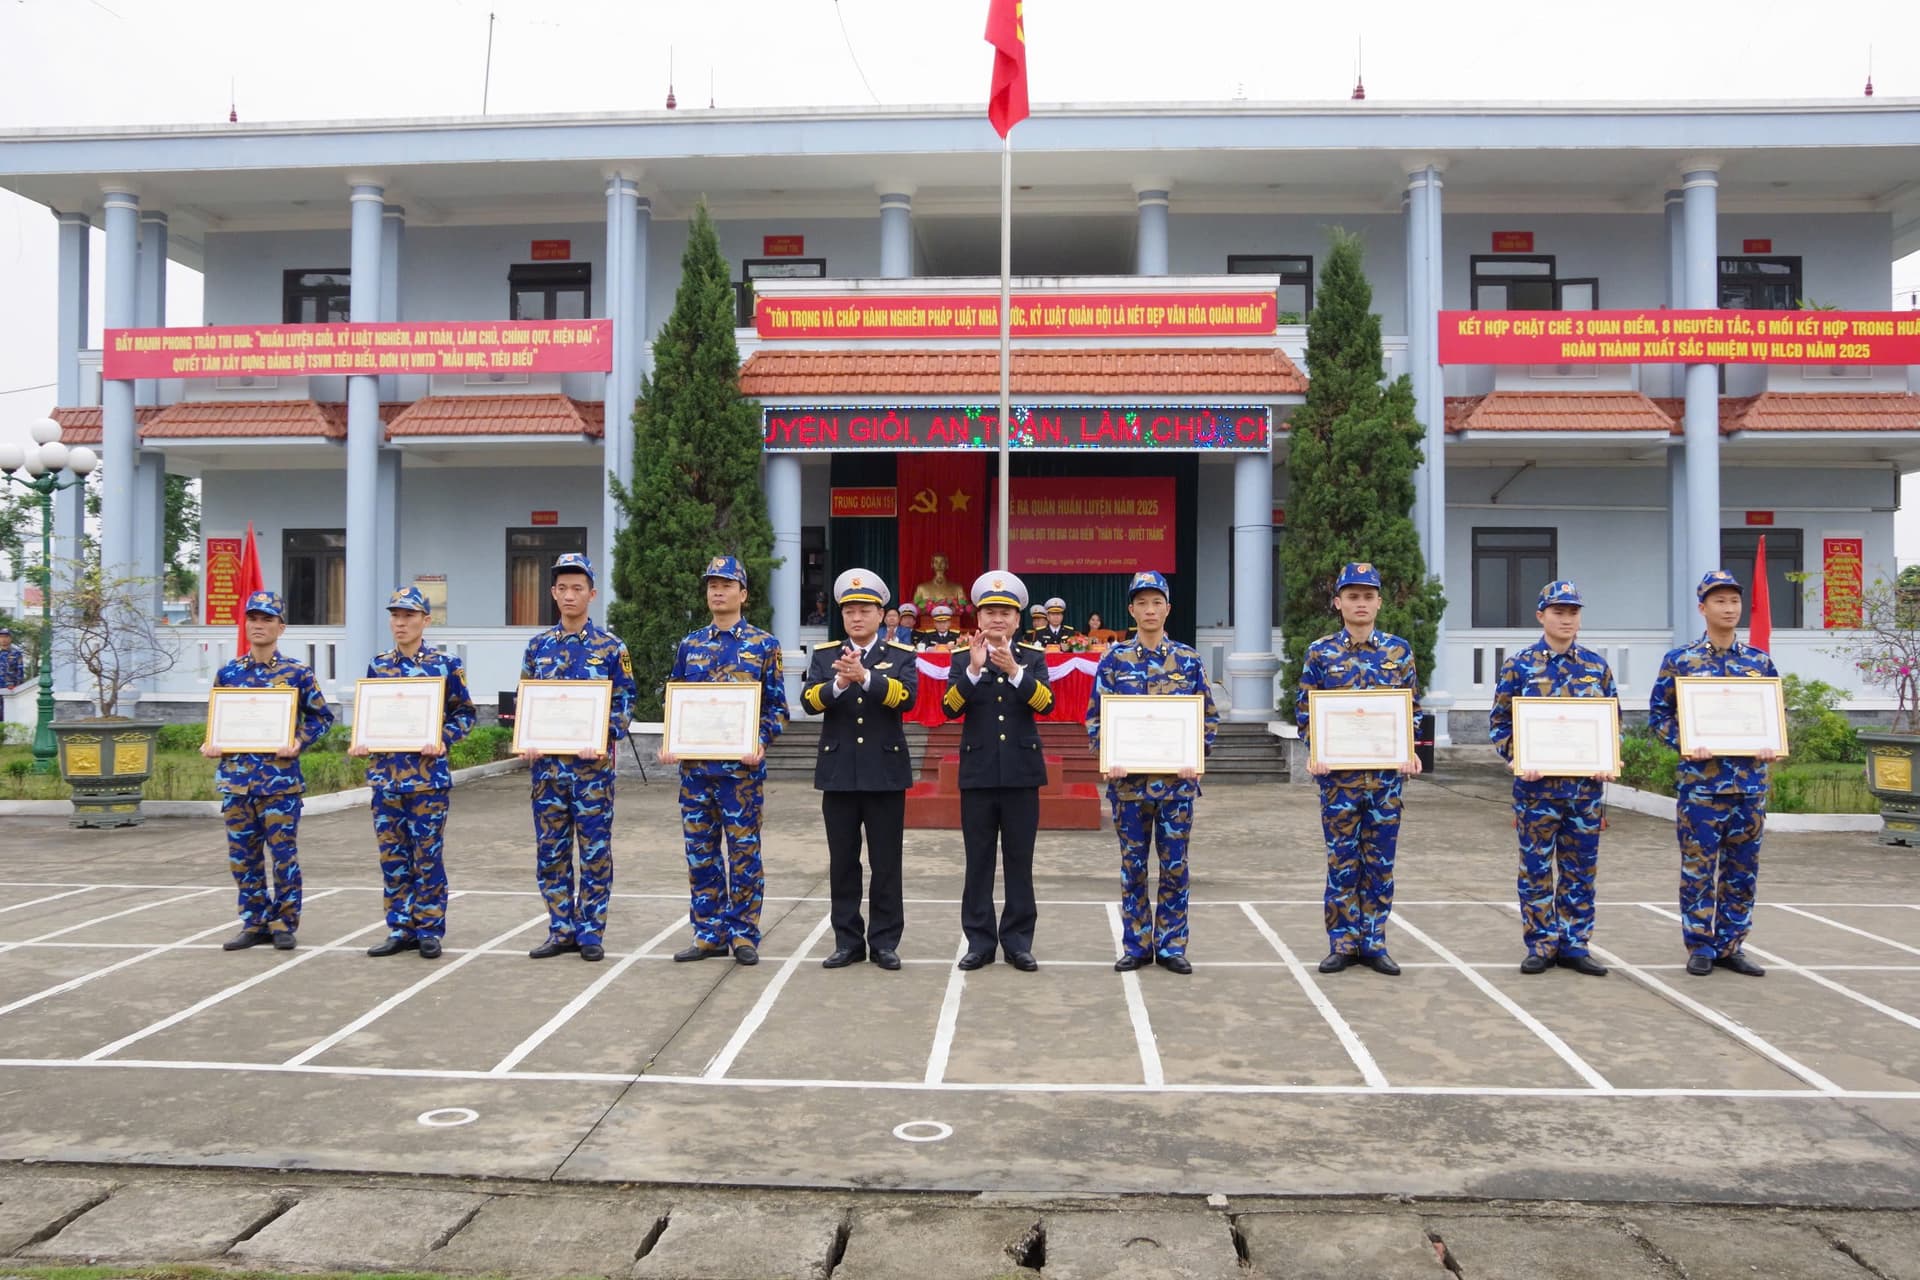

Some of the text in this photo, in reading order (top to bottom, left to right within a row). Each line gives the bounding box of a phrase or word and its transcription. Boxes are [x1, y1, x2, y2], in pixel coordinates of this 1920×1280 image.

[766, 306, 789, 328] "TÔN
[790, 310, 820, 332] TRỌNG
[822, 306, 834, 328] VÀ
[836, 304, 860, 327] CHẤP
[863, 306, 888, 327] HÀNH
[890, 306, 925, 327] NGHIÊM
[928, 305, 952, 327] PHÁP
[955, 305, 976, 331] LUẬT
[978, 304, 998, 327] NHÀ
[1030, 303, 1041, 327] KỶ
[1044, 305, 1066, 329] LUẬT
[1069, 305, 1094, 328] QUÂN
[1096, 305, 1111, 329] ĐỘI
[1114, 304, 1125, 325] LÀ
[1127, 304, 1145, 325] NÉT
[1147, 306, 1165, 328] ĐẸP
[1167, 304, 1186, 325] VĂN
[1188, 303, 1207, 325] HÓA
[1209, 304, 1234, 326] QUÂN
[1236, 302, 1267, 325] NHÂN"
[1458, 316, 1481, 336] KẾT
[1484, 319, 1510, 338] HỢP
[1513, 318, 1545, 339] CHẶT
[1576, 320, 1584, 335] 3
[1587, 319, 1620, 336] QUAN
[1623, 314, 1659, 336] ĐIỂM,
[1662, 319, 1670, 334] 8
[1673, 316, 1724, 334] NGUYÊN
[1726, 314, 1755, 336] TẮC,
[1757, 320, 1765, 335] 6
[1769, 316, 1793, 336] MỐI
[1797, 316, 1820, 336] KẾT
[1823, 319, 1848, 339] HỢP
[1851, 320, 1894, 336] TRONG
[162, 335, 192, 350] PHONG
[218, 334, 232, 349] THI
[286, 330, 313, 350] LUYỆN
[351, 329, 373, 350] LUẬT
[414, 331, 427, 346] AN
[457, 327, 477, 345] LÀM
[502, 326, 530, 345] CHÍNH
[553, 327, 575, 347] HIỆN
[1561, 336, 1871, 360] HOÀN THÀNH XUẤT SẮC NHIỆM VỤ HLCĐ NĂM 2025
[172, 353, 200, 373] QUYẾT
[202, 353, 221, 371] TÂM
[222, 353, 239, 371] XÂY
[308, 353, 332, 369] TSVM
[334, 351, 353, 368] TIÊU
[491, 349, 510, 367] TIÊU
[849, 410, 919, 445] GIỎI,
[927, 416, 969, 442] AN
[1081, 410, 1141, 441] LÀM
[834, 495, 858, 509] TRUNG
[1137, 499, 1159, 516] 2025
